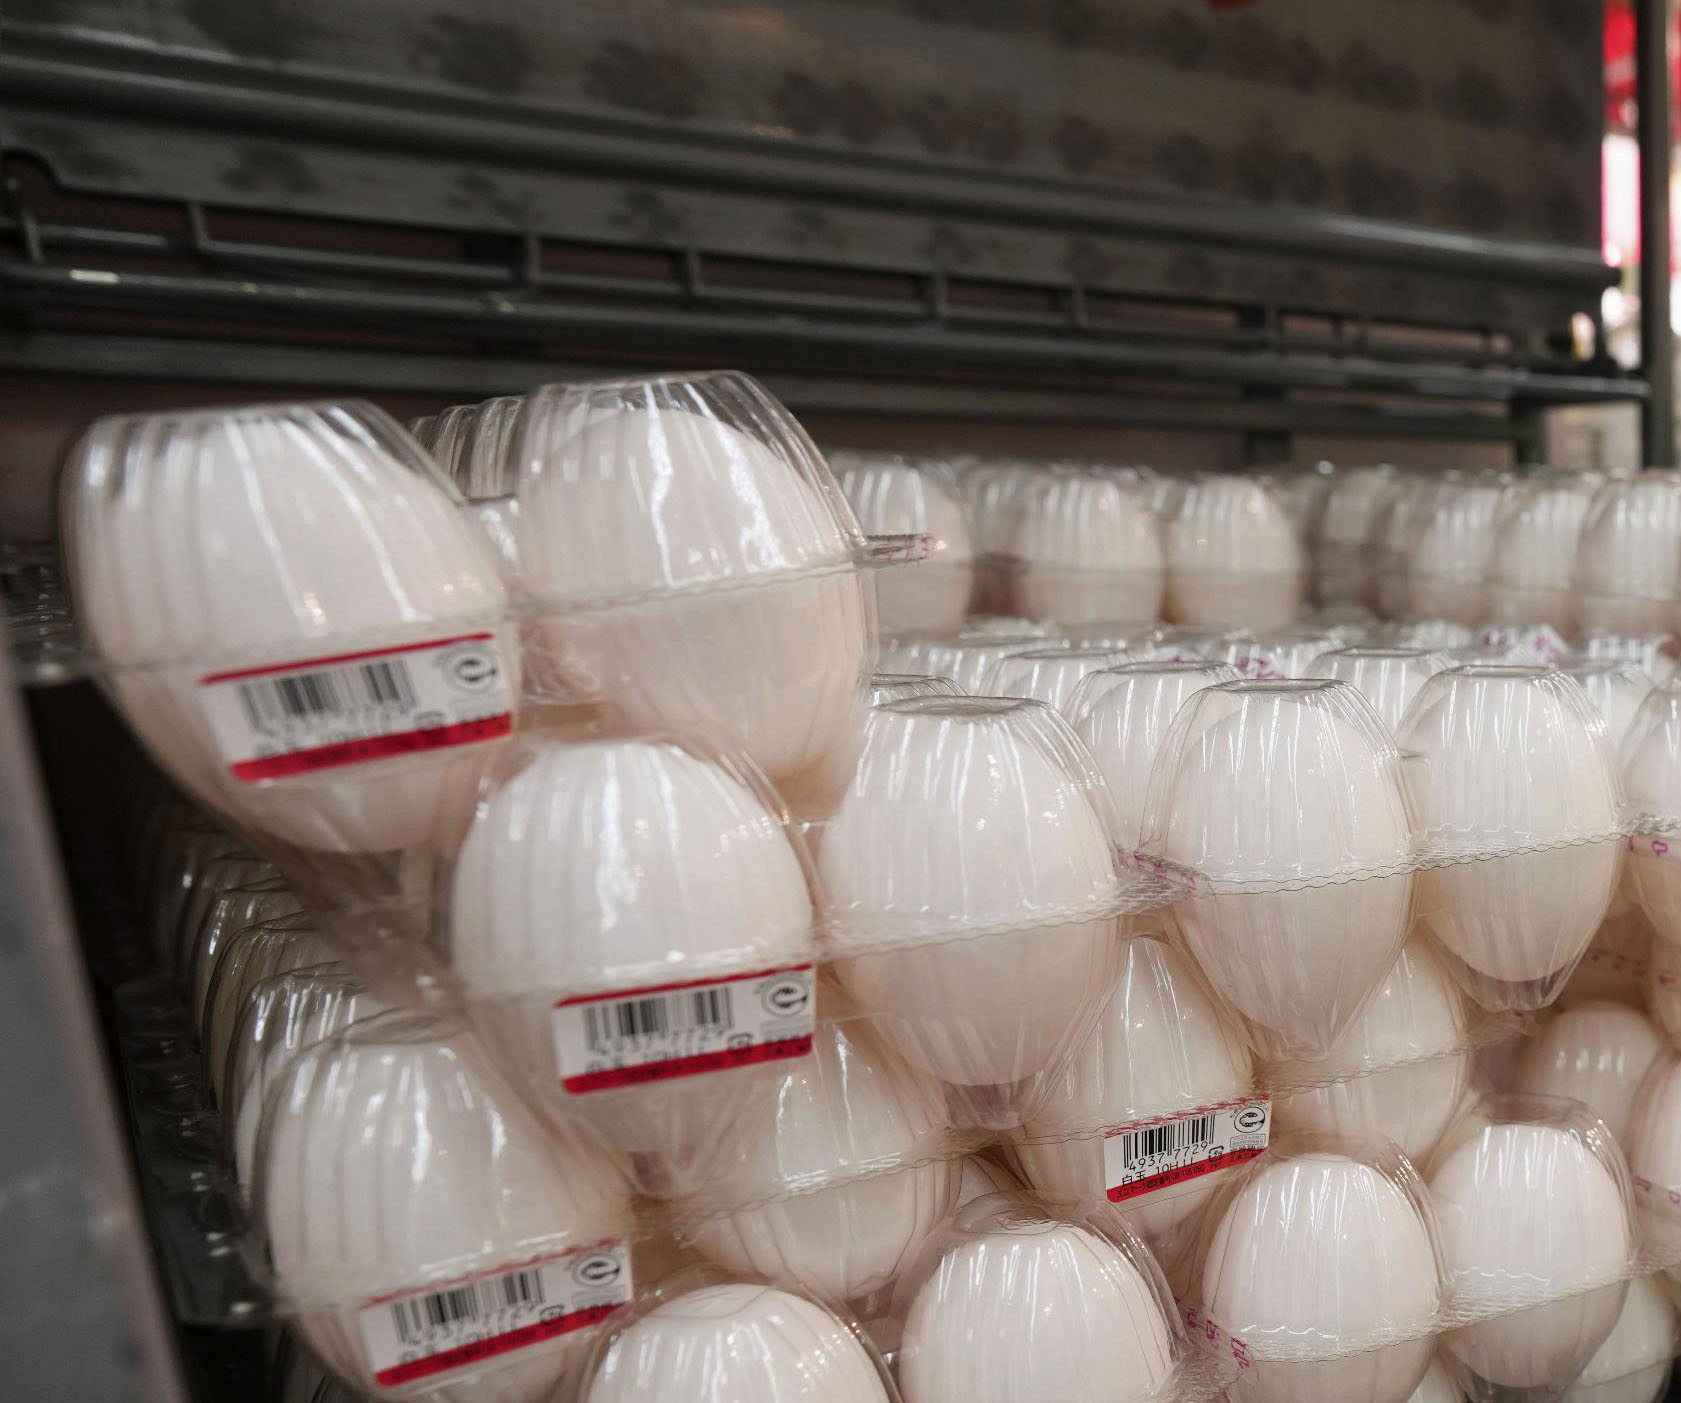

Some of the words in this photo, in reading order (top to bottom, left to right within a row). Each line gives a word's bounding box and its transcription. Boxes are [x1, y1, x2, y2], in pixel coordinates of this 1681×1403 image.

[1129, 1153, 1165, 1171] 4937
[1174, 1140, 1209, 1160] 7729
[1121, 1170, 1147, 1186] 白玉
